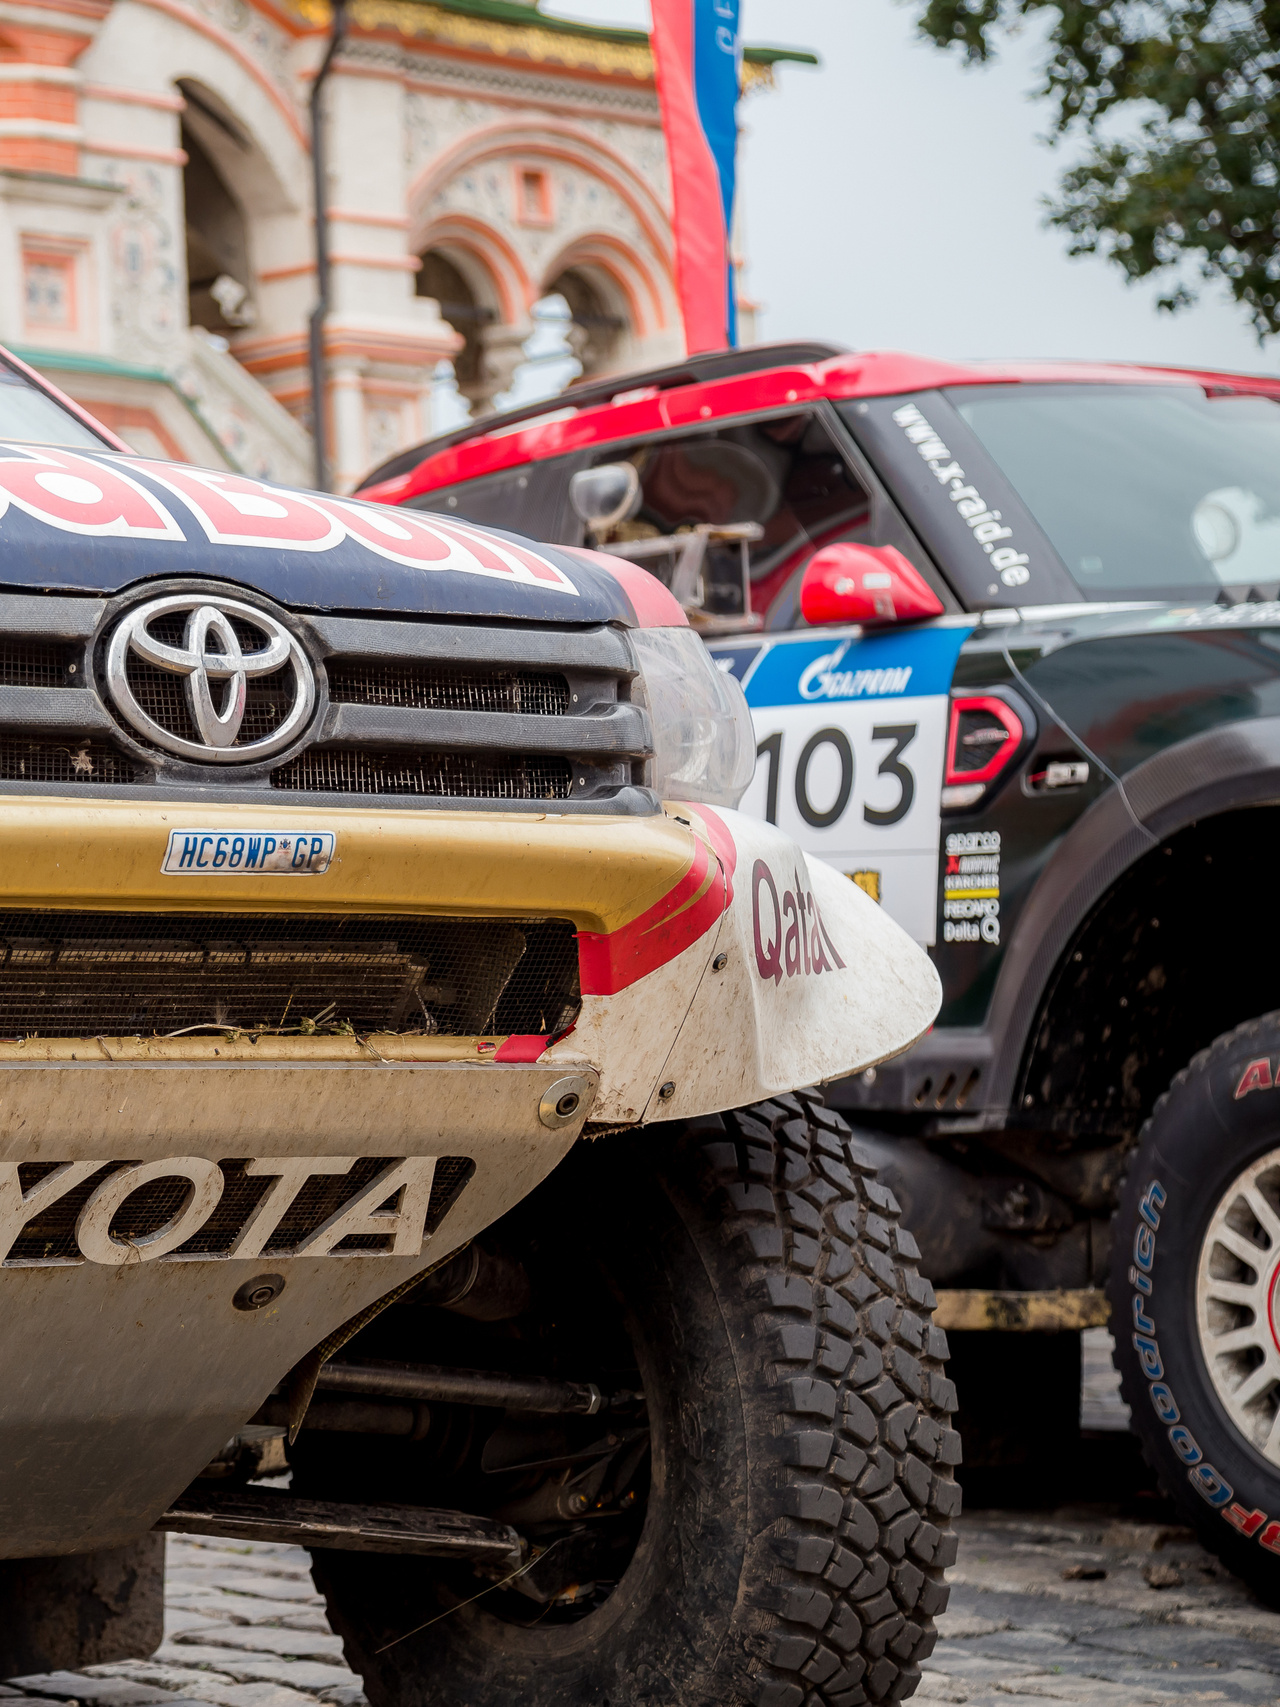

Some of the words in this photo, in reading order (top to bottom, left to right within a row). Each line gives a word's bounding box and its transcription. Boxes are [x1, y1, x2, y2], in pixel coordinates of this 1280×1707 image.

[88, 453, 580, 596] Bull
[892, 403, 1031, 587] www.x-raid.de
[756, 724, 918, 828] 103
[179, 837, 277, 868] HC68WP
[291, 837, 323, 868] GP
[945, 831, 1001, 855] sparco
